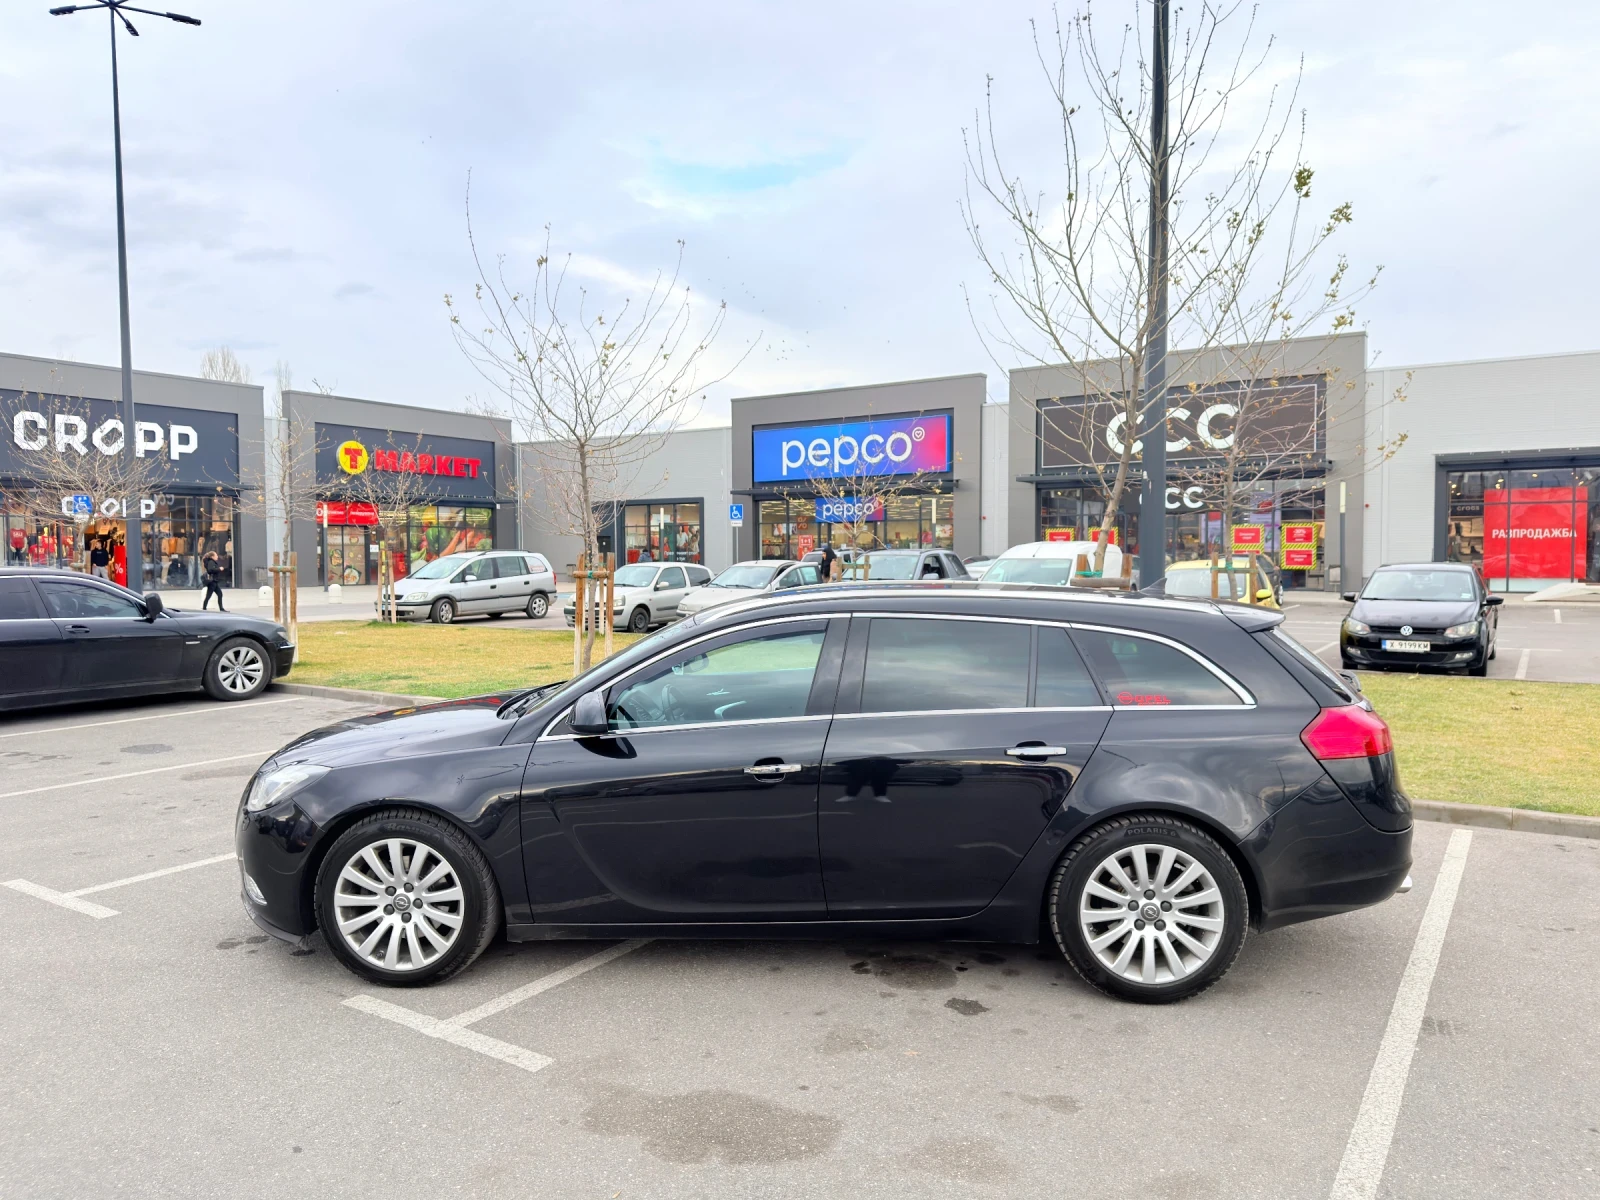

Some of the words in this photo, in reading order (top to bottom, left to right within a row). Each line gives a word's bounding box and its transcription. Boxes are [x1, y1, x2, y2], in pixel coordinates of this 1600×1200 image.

[14, 411, 198, 460] CROPP
[344, 448, 363, 469] T
[374, 449, 481, 478] MARKET
[781, 431, 913, 476] pepco
[61, 496, 156, 518] COP
[1138, 486, 1204, 510] CC
[822, 502, 875, 519] pepco
[1492, 528, 1577, 539] РАЗПРОДАЖБА
[1127, 827, 1168, 836] POLARIS
